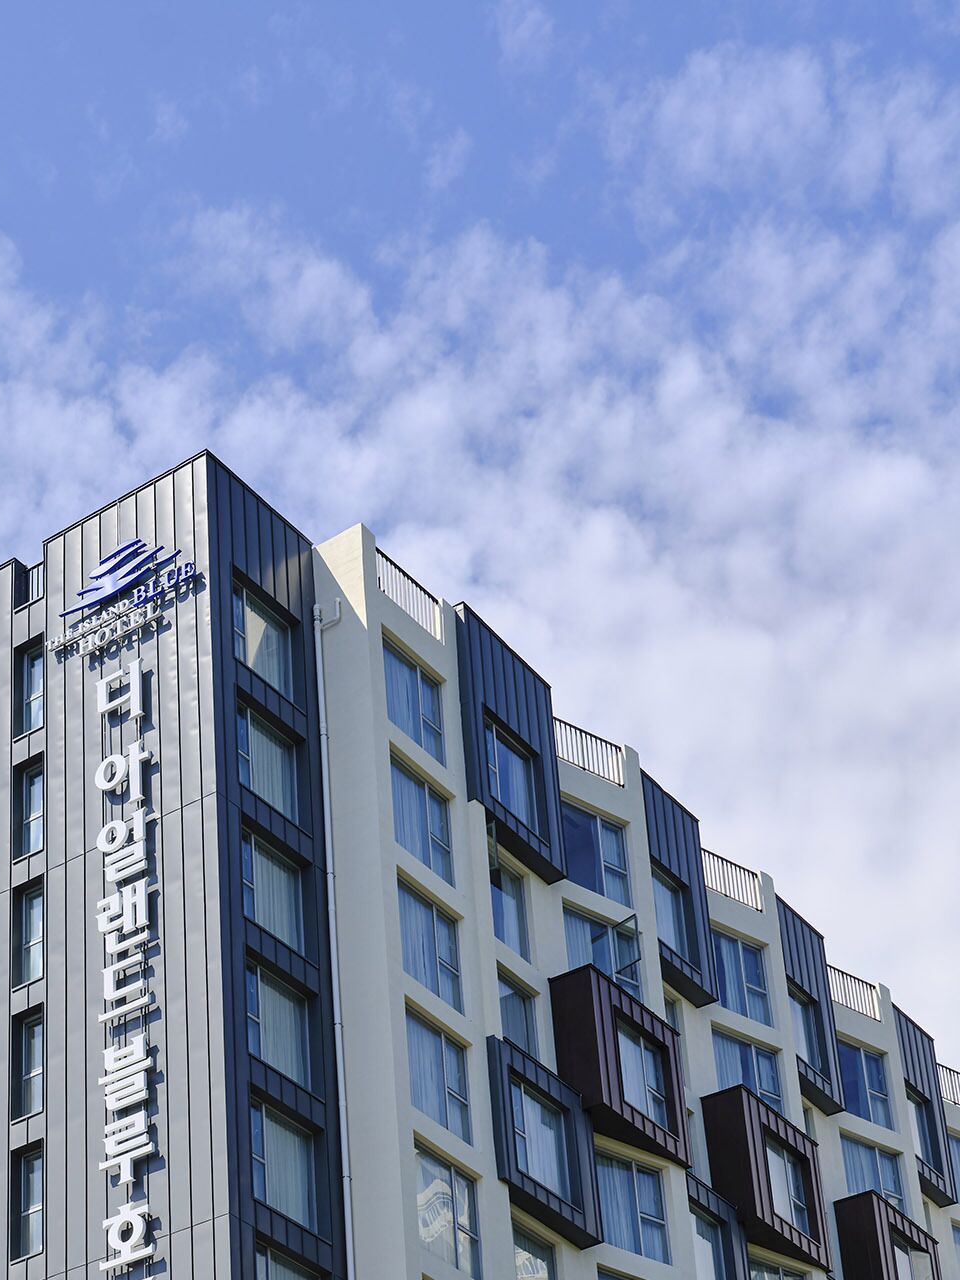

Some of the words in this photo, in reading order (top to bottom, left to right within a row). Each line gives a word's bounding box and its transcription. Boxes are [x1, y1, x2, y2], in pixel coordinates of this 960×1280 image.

[78, 598, 133, 632] ISLAND
[132, 560, 196, 607] BLUE
[77, 603, 162, 657] HOTEL
